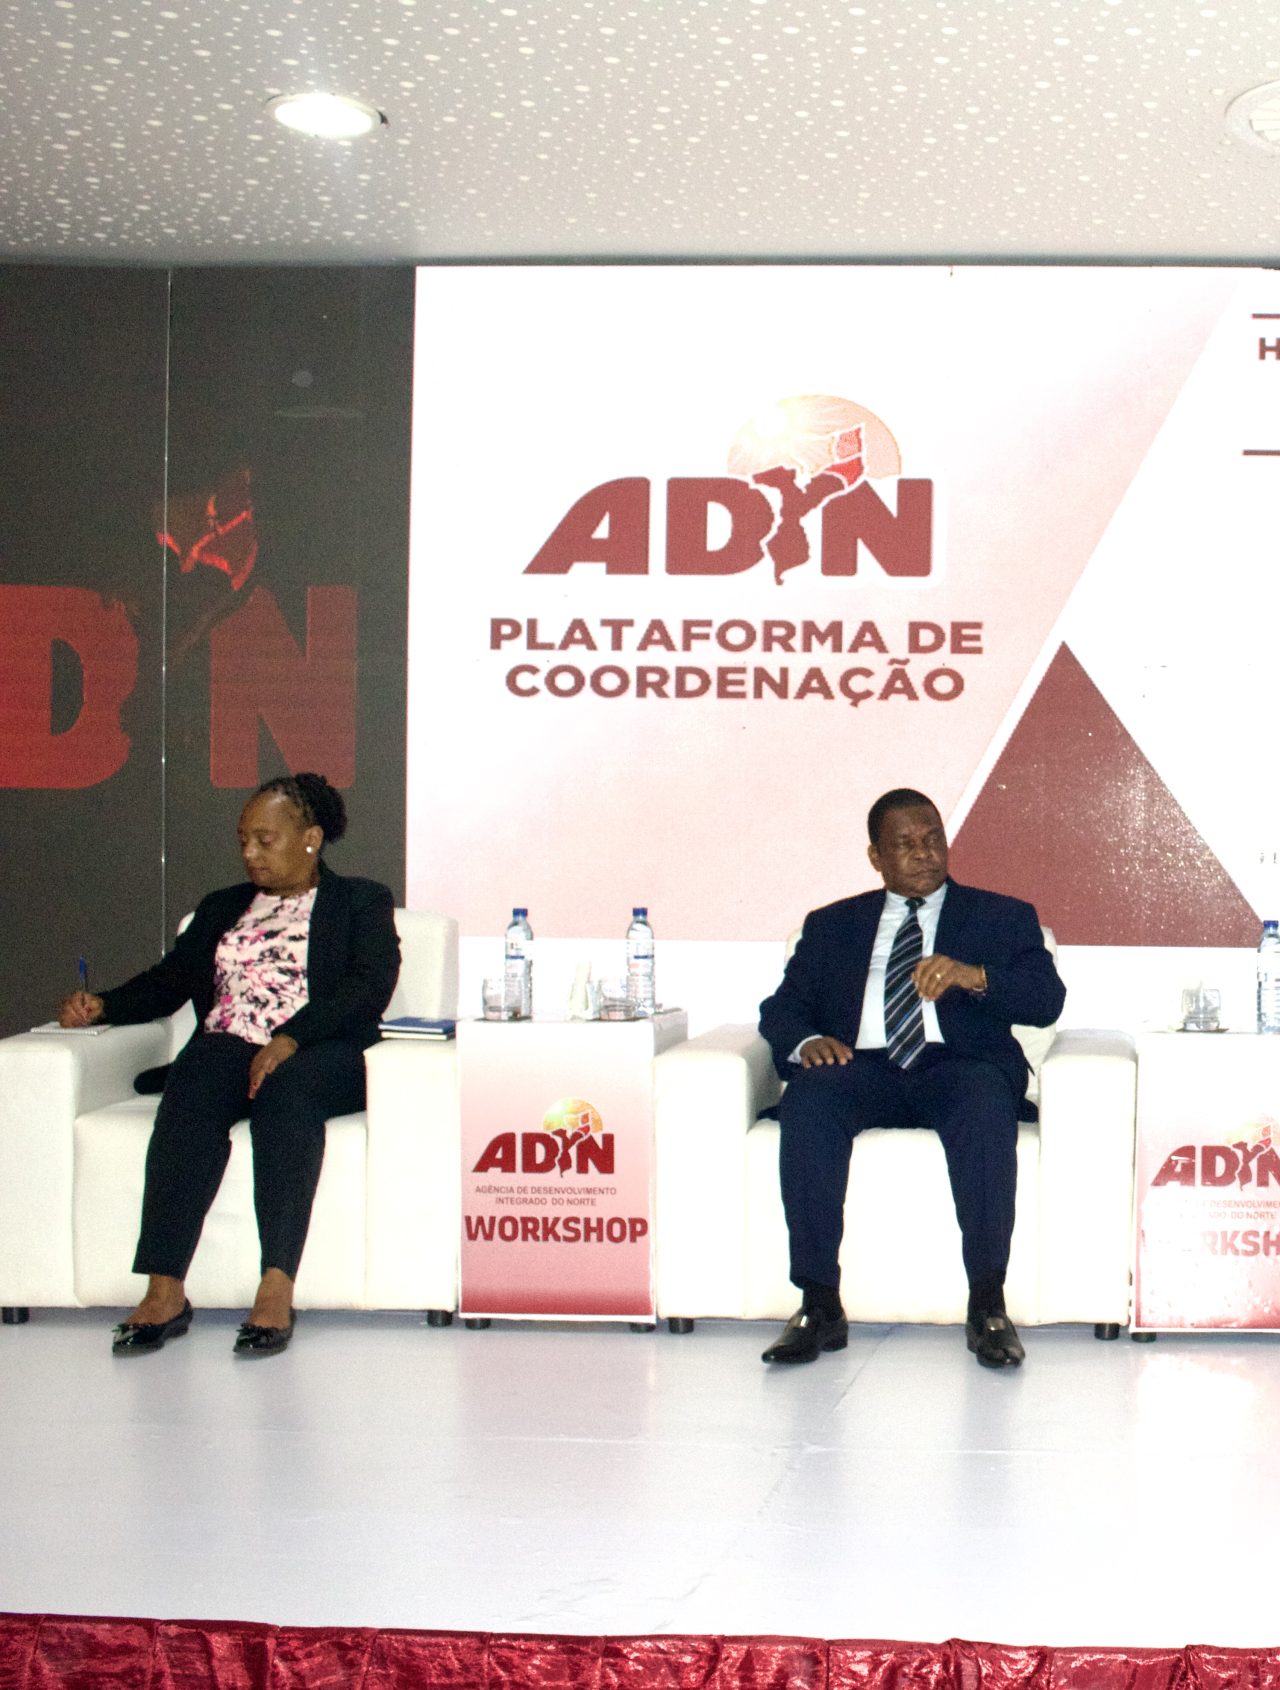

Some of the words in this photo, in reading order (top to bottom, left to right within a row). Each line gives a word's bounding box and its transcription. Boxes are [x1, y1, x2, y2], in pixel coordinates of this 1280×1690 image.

[489, 617, 888, 654] PLATAFORMA
[908, 621, 984, 655] DE
[505, 658, 965, 707] COORDENAÇÃO
[475, 1185, 515, 1195] AGÊNCIA
[516, 1187, 529, 1195] DE
[530, 1187, 617, 1196] DESENVOLVIMENTO
[496, 1197, 548, 1206] INTEGRADO
[551, 1198, 565, 1206] DO
[566, 1198, 598, 1207] NORTE
[464, 1215, 649, 1244] WORKSHOP
